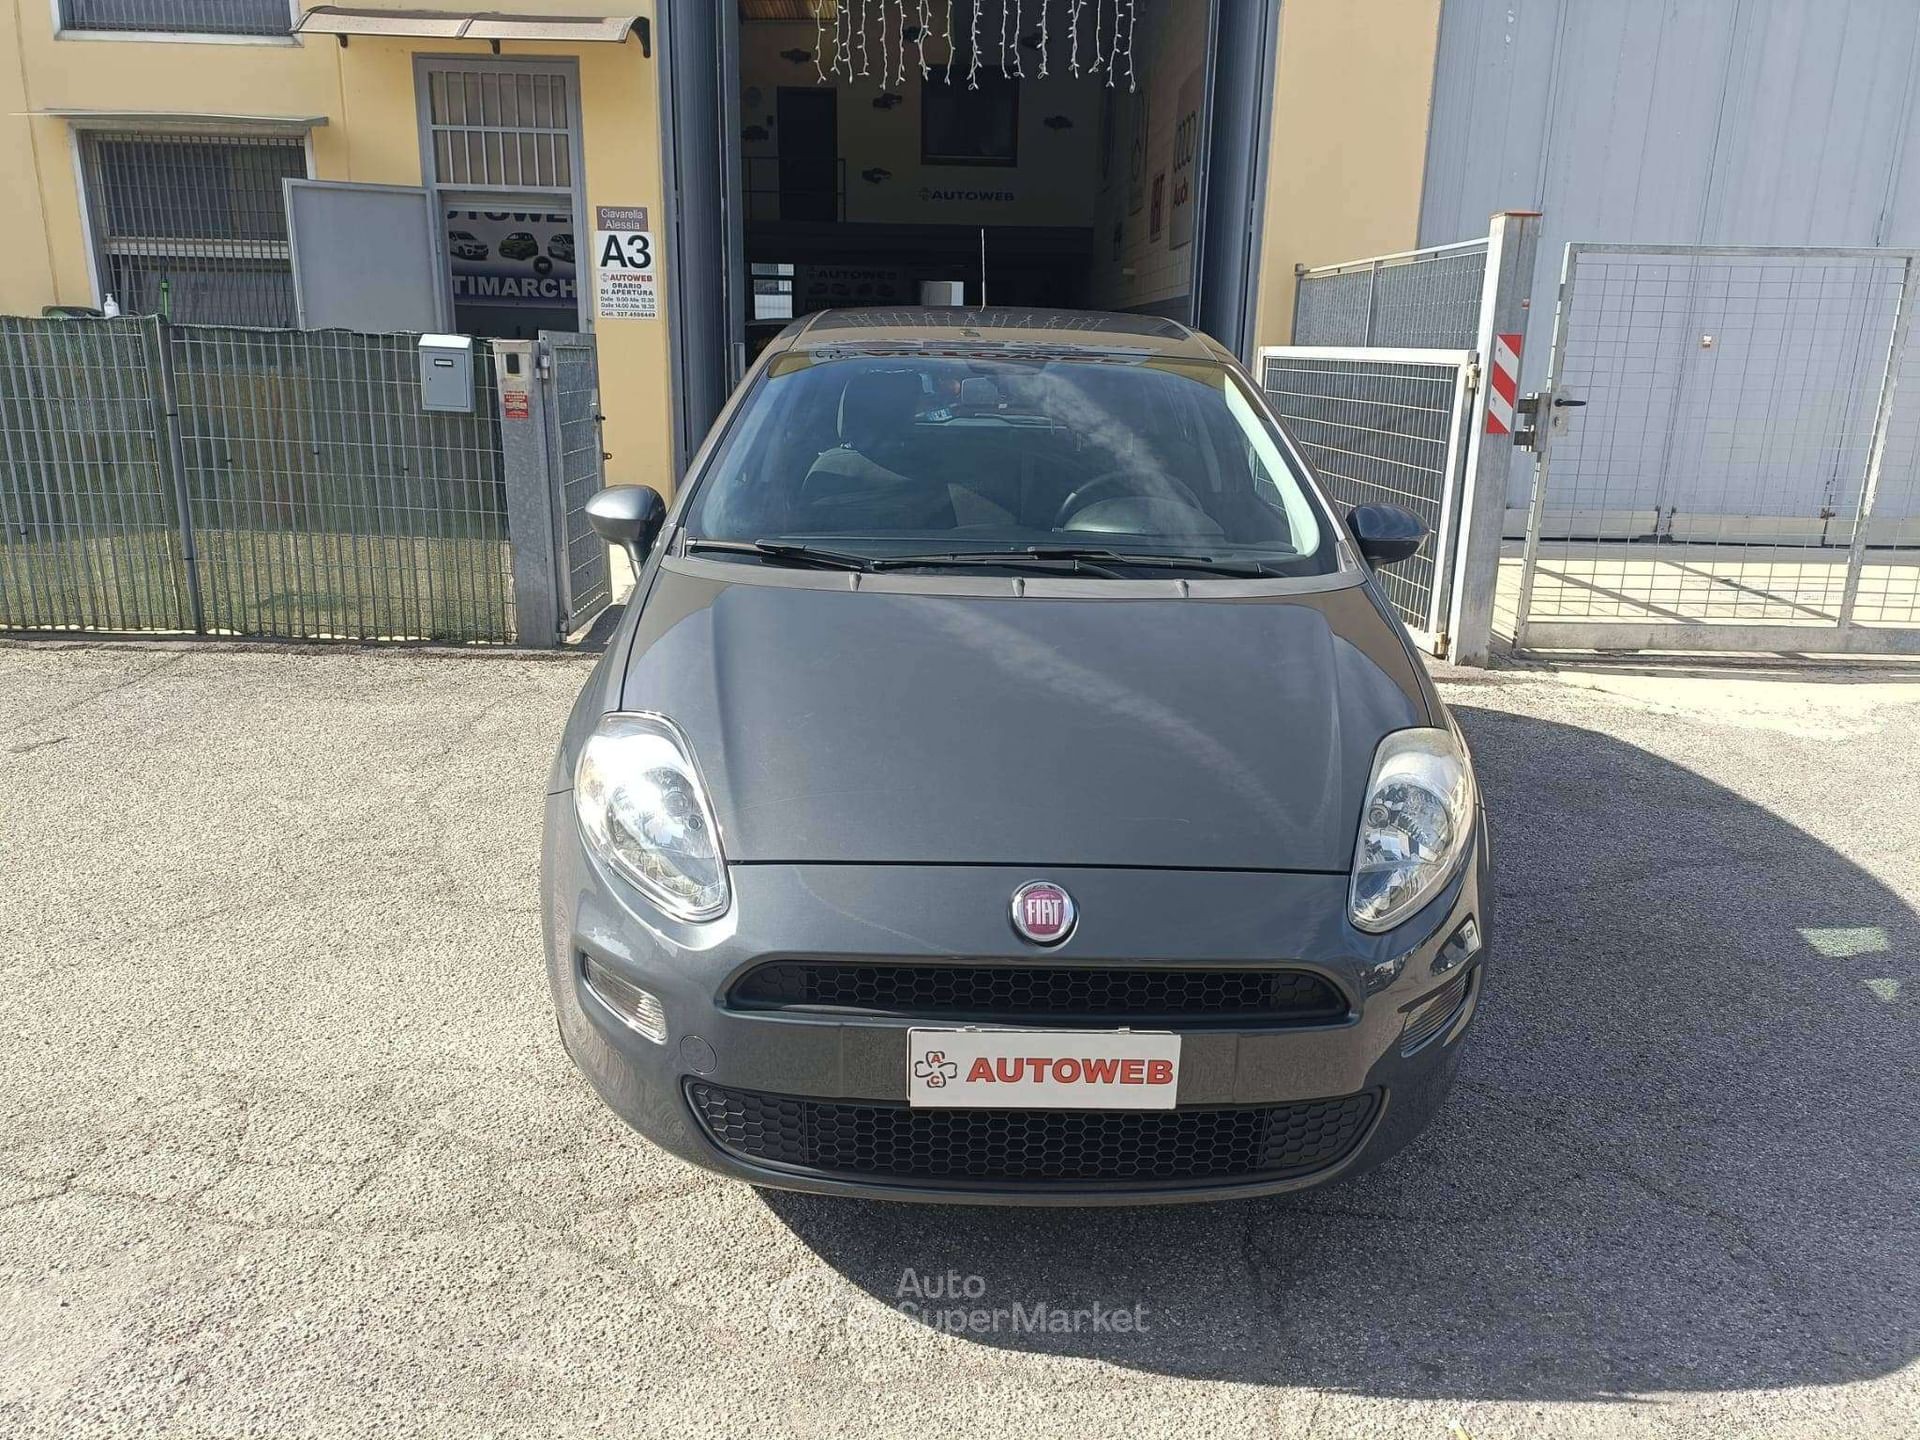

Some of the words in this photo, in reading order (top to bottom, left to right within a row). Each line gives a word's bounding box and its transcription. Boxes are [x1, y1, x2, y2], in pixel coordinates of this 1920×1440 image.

[931, 190, 1014, 201] AUTOWEB
[601, 208, 644, 219] Ciavarella
[605, 220, 640, 230] Alessia
[600, 234, 652, 269] A3
[610, 274, 653, 282] AUTOWEB
[1027, 899, 1061, 925] FIAT
[966, 1057, 1174, 1085] AUTOWEB
